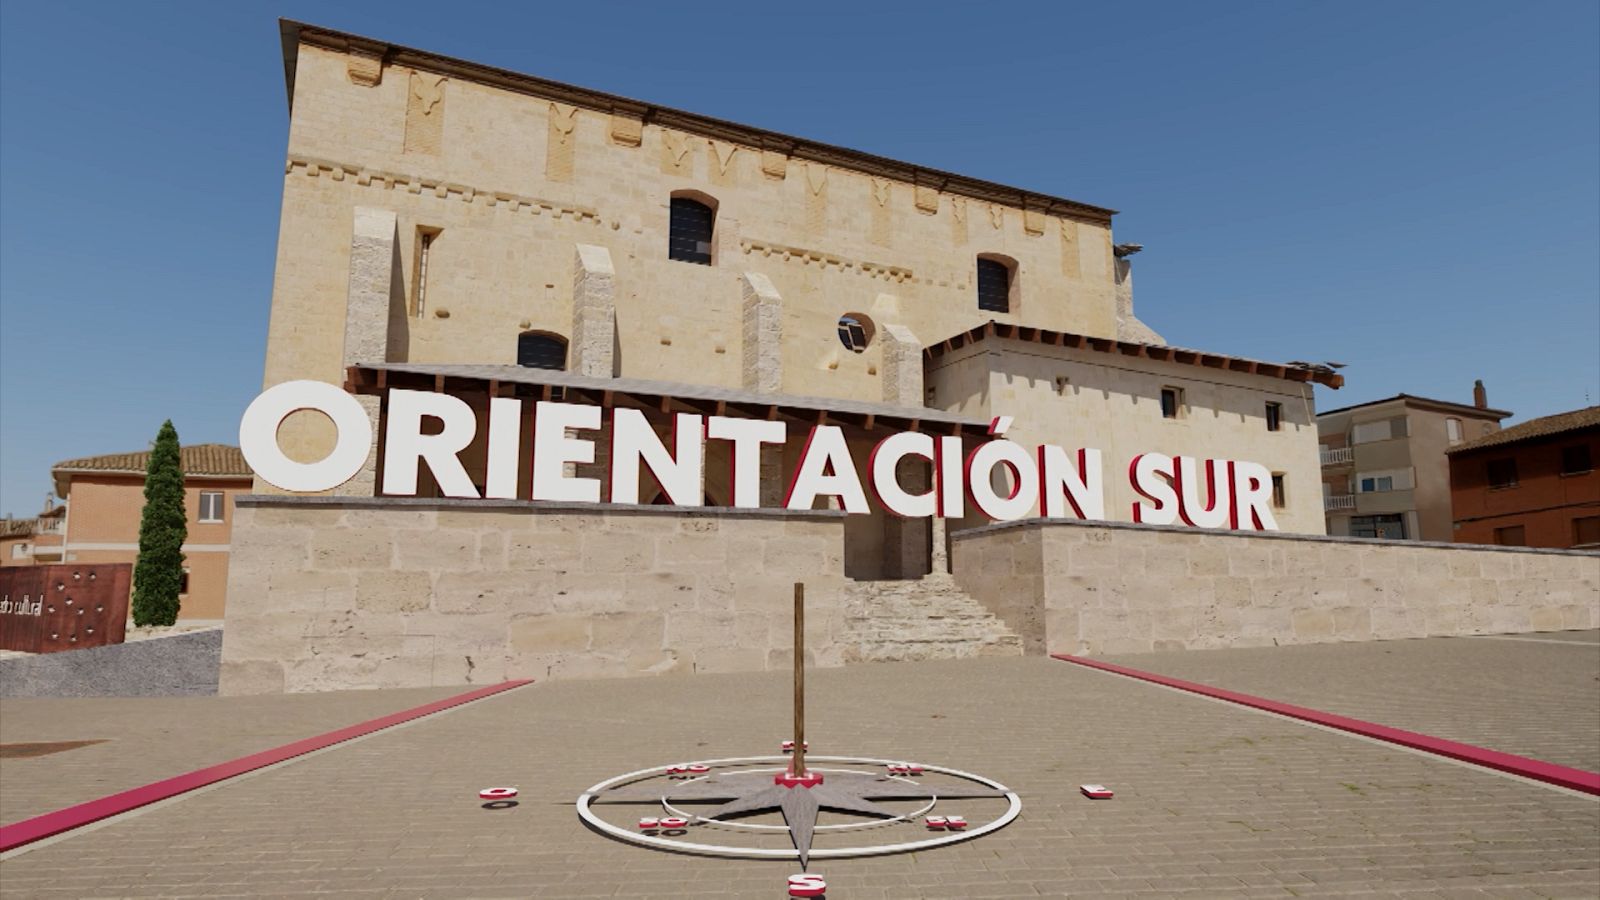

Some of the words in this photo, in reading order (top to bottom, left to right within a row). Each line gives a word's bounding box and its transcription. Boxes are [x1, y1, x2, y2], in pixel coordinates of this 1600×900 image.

[239, 380, 1101, 521] ORIENTACIÓN
[1129, 452, 1280, 531] SUR
[480, 787, 518, 800] O
[788, 874, 826, 897] S
